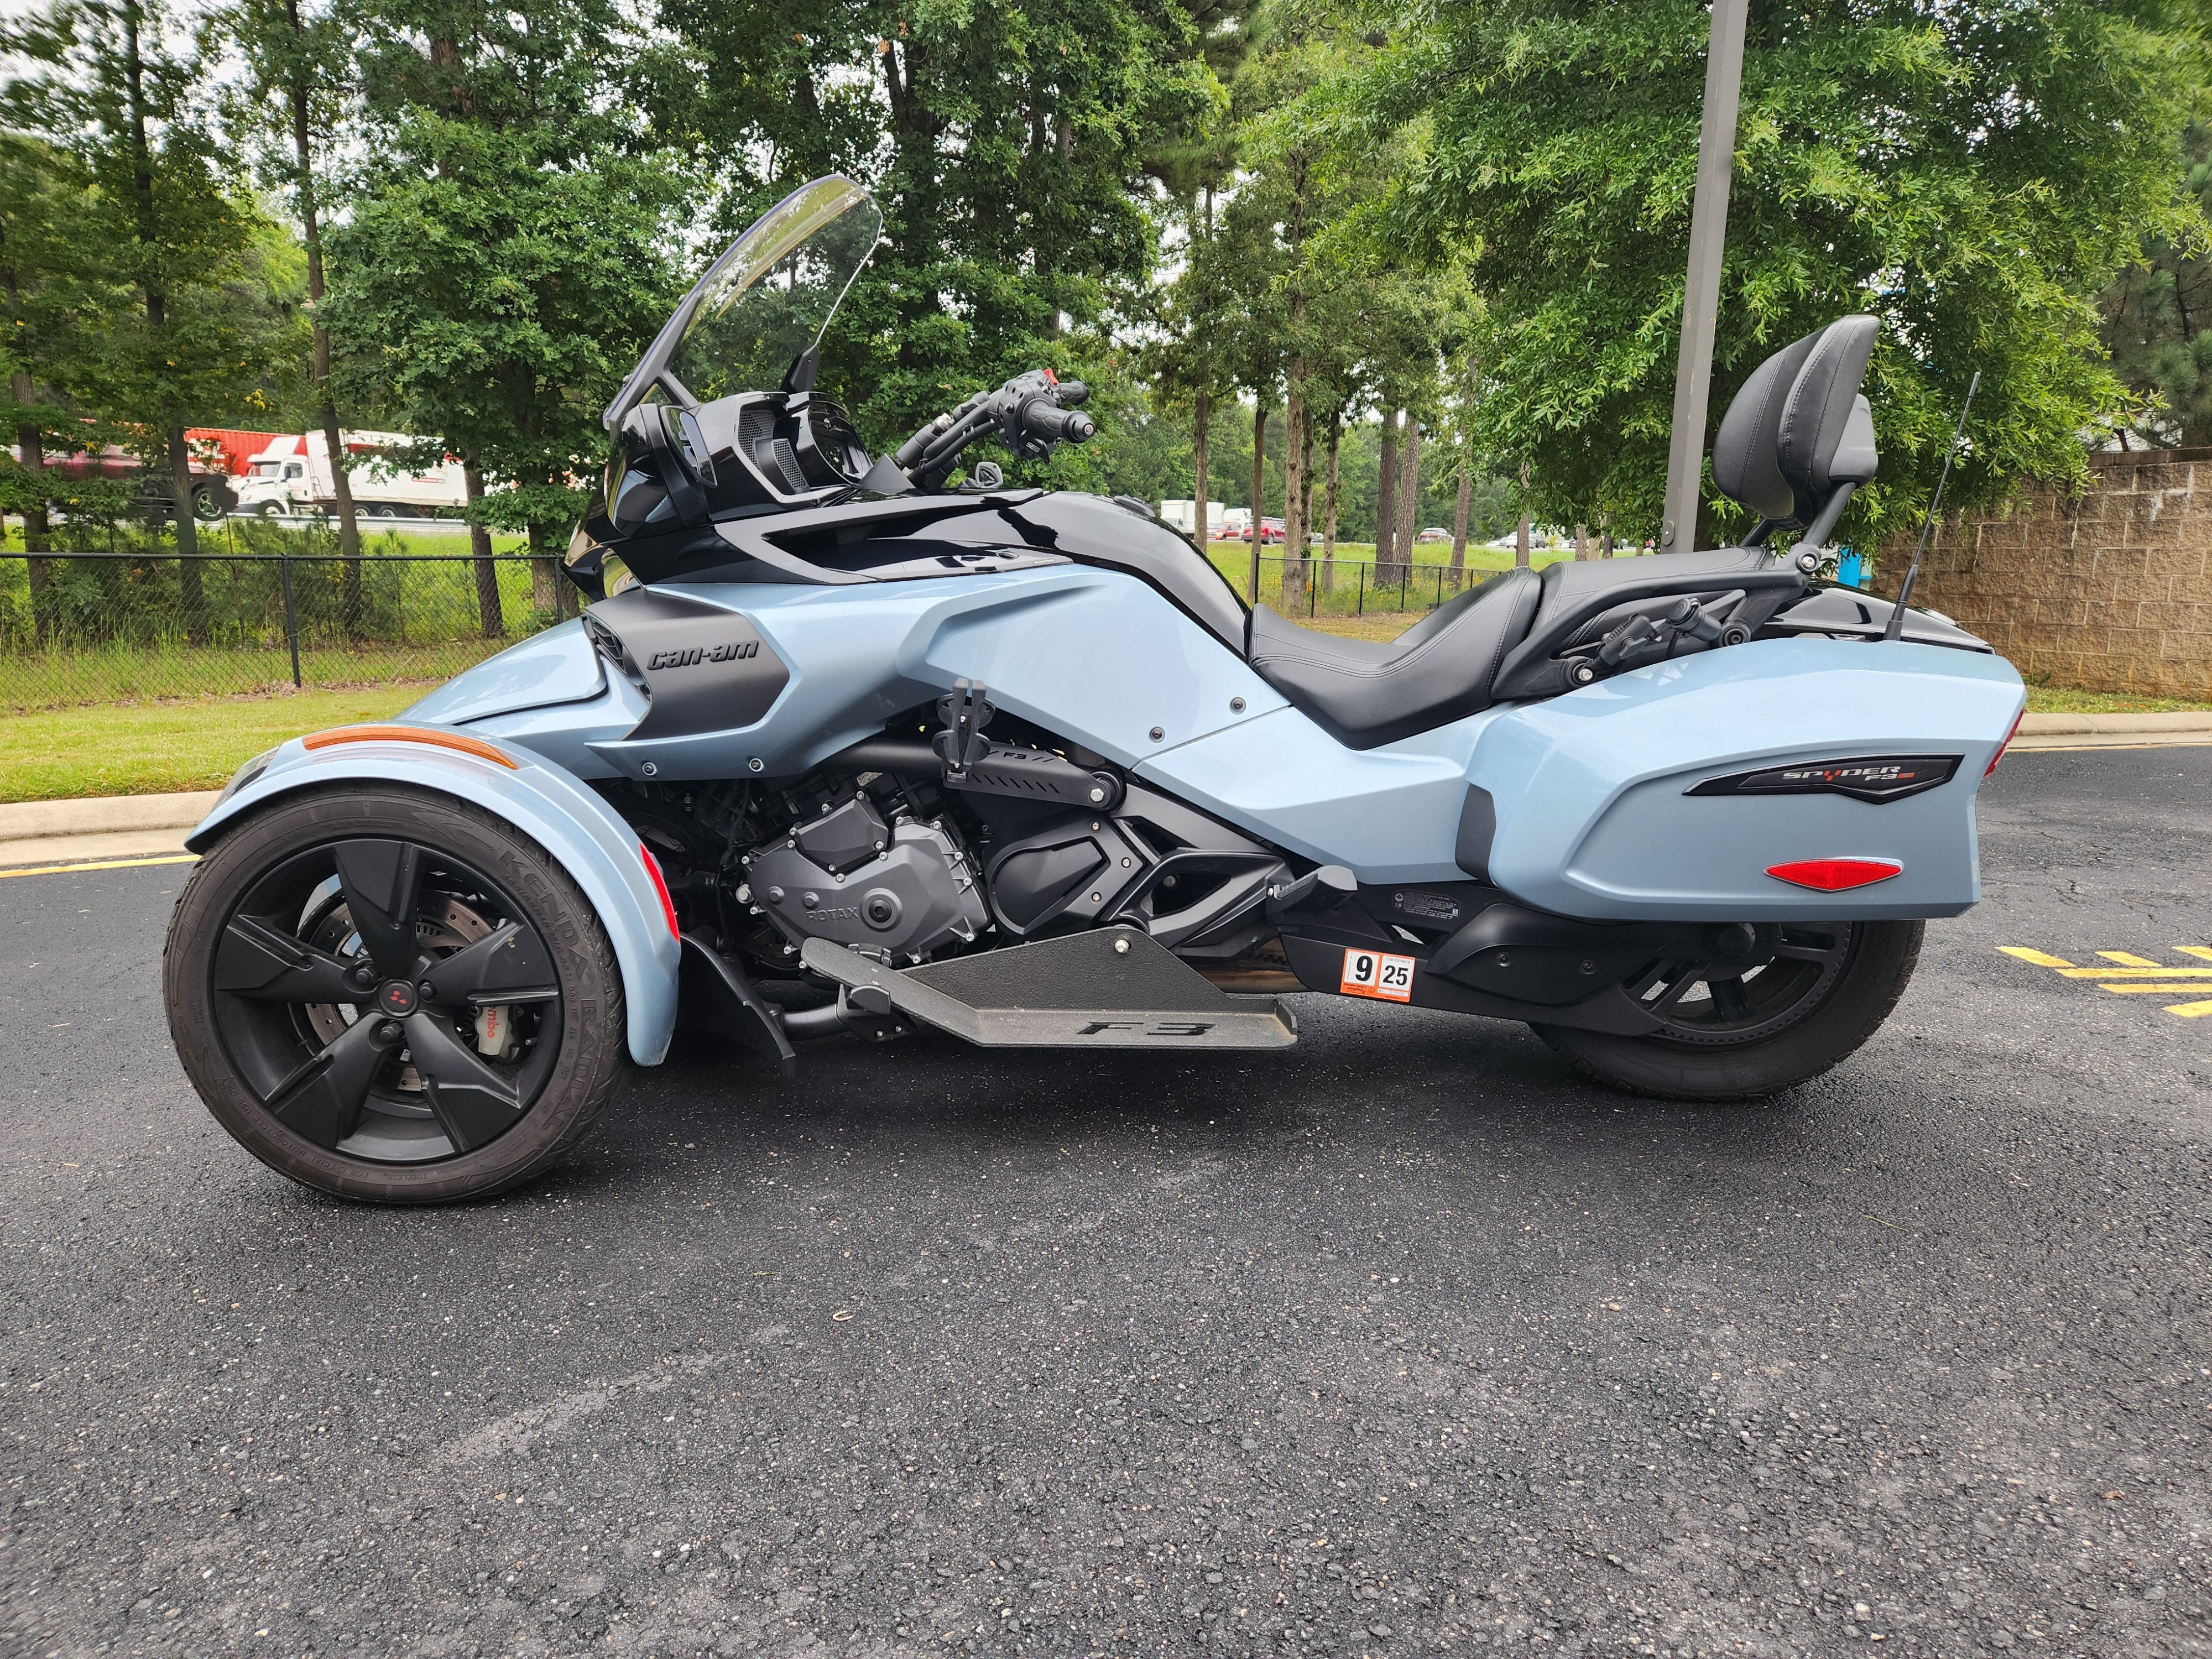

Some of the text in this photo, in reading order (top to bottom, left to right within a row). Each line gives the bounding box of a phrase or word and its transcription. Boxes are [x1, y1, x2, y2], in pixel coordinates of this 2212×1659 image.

[646, 639, 759, 671] can-am
[1782, 766, 1901, 782] SPYDER
[806, 906, 858, 922] ROTAX
[1355, 956, 1373, 982] 9
[1383, 965, 1408, 985] 25
[497, 849, 598, 1130] KENDA RADIAL
[1076, 1021, 1217, 1036] F3
[220, 1074, 368, 1178] FOR SPECIAL MOTORCYCLE USE ONLY
[387, 1172, 427, 1181] TUBELESS
